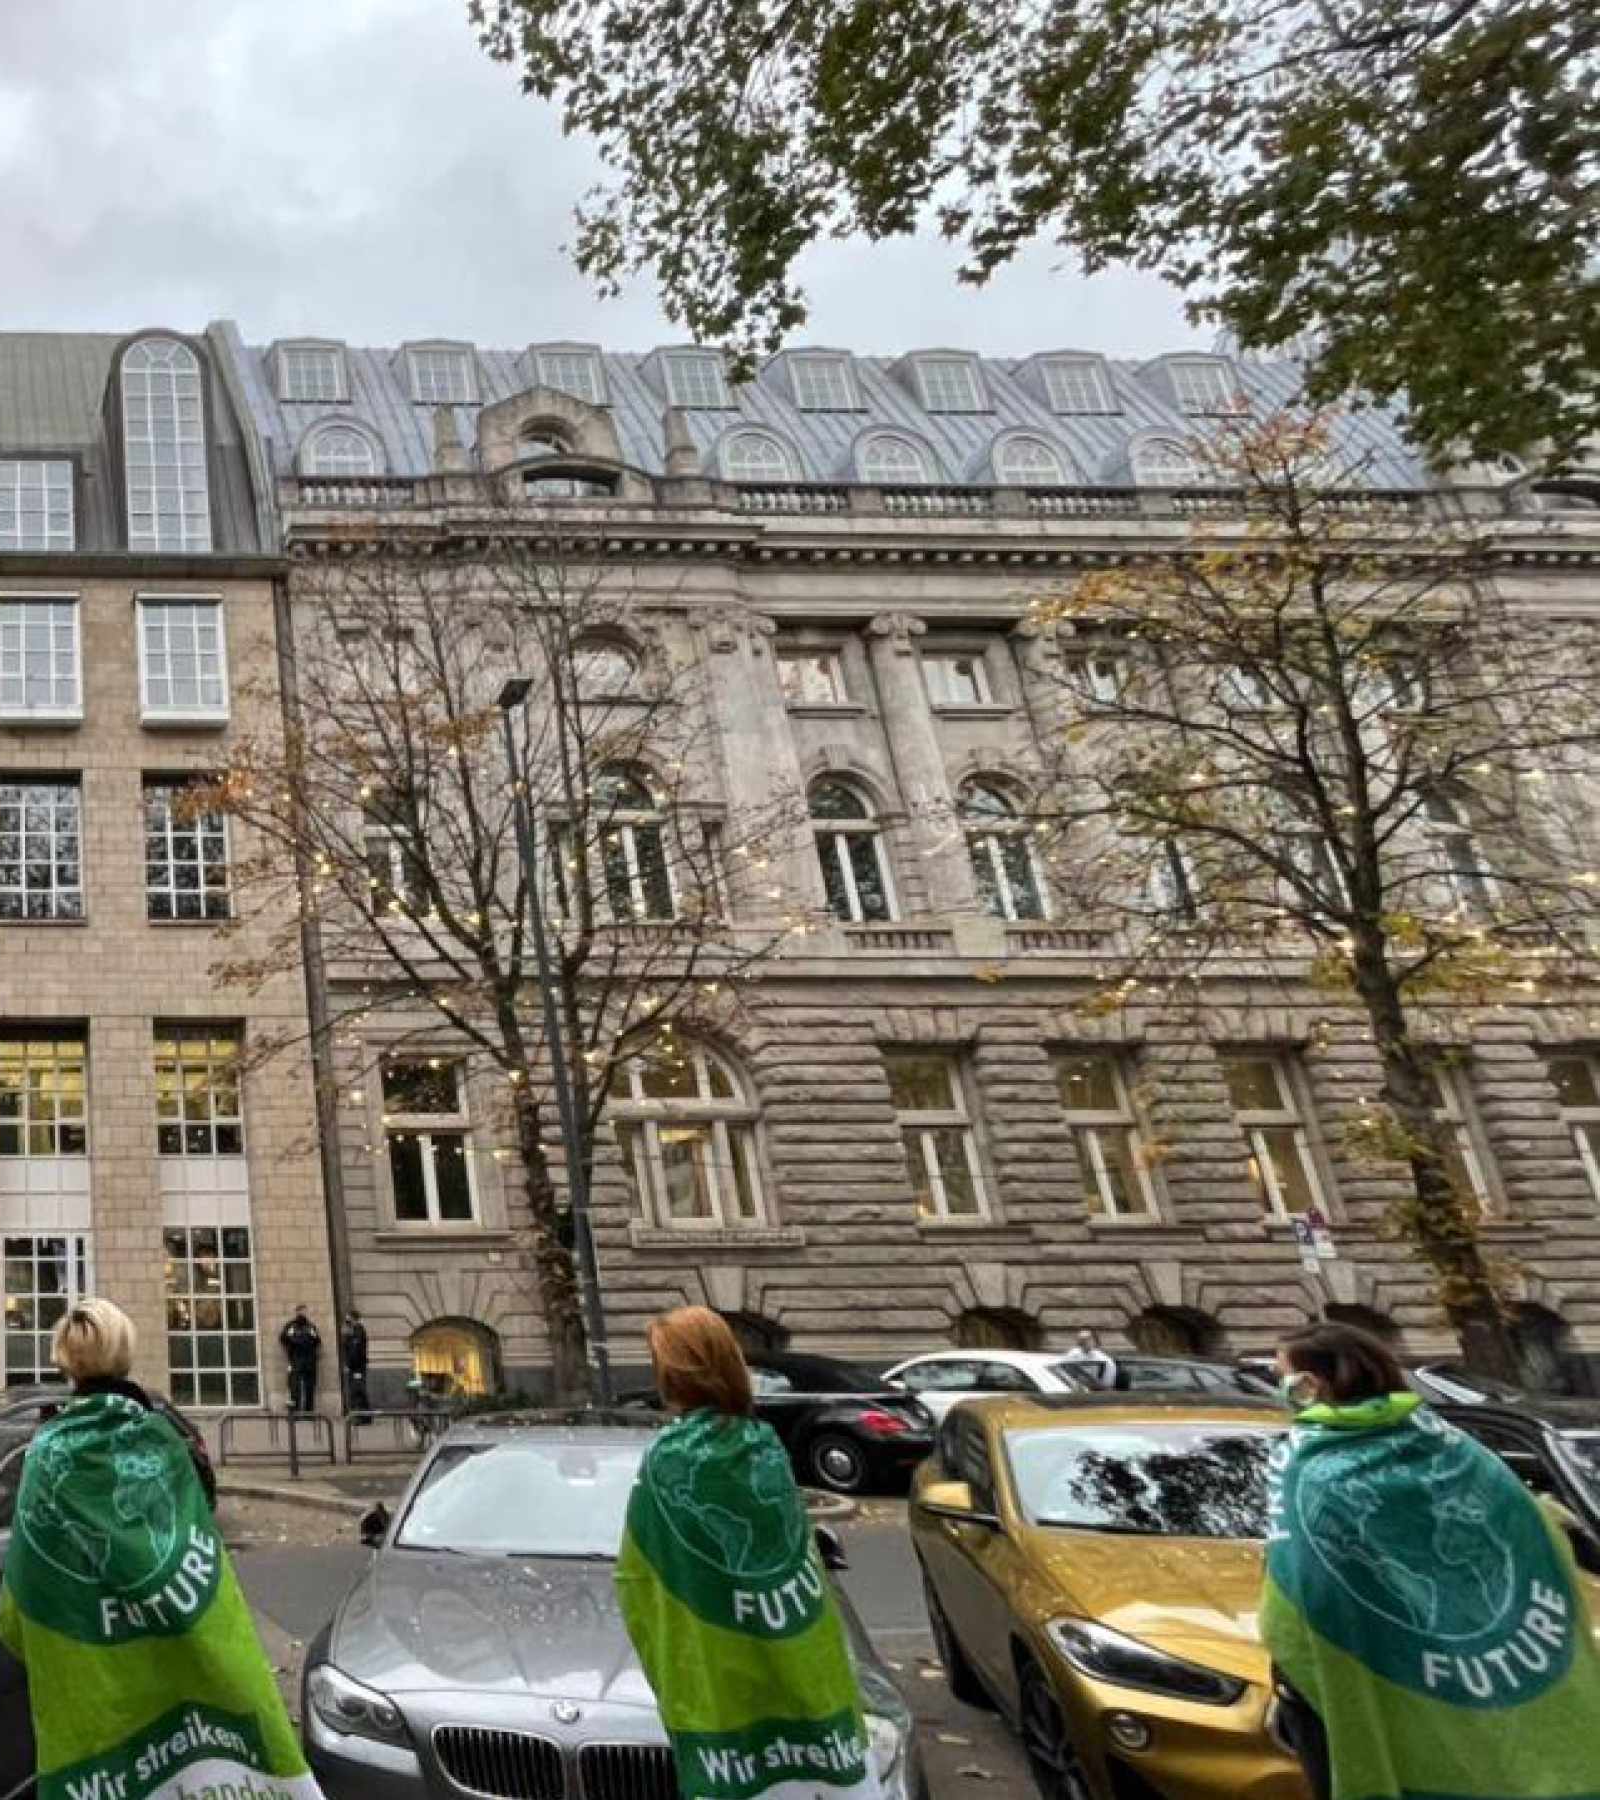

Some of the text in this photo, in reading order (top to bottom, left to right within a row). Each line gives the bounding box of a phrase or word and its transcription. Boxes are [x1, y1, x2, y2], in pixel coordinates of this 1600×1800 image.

[100, 1523, 217, 1636] FUTURE
[733, 1555, 824, 1630] FUTU
[1421, 1579, 1567, 1698] FUTURE
[135, 1711, 258, 1781] streiken,
[696, 1745, 756, 1785] Wir
